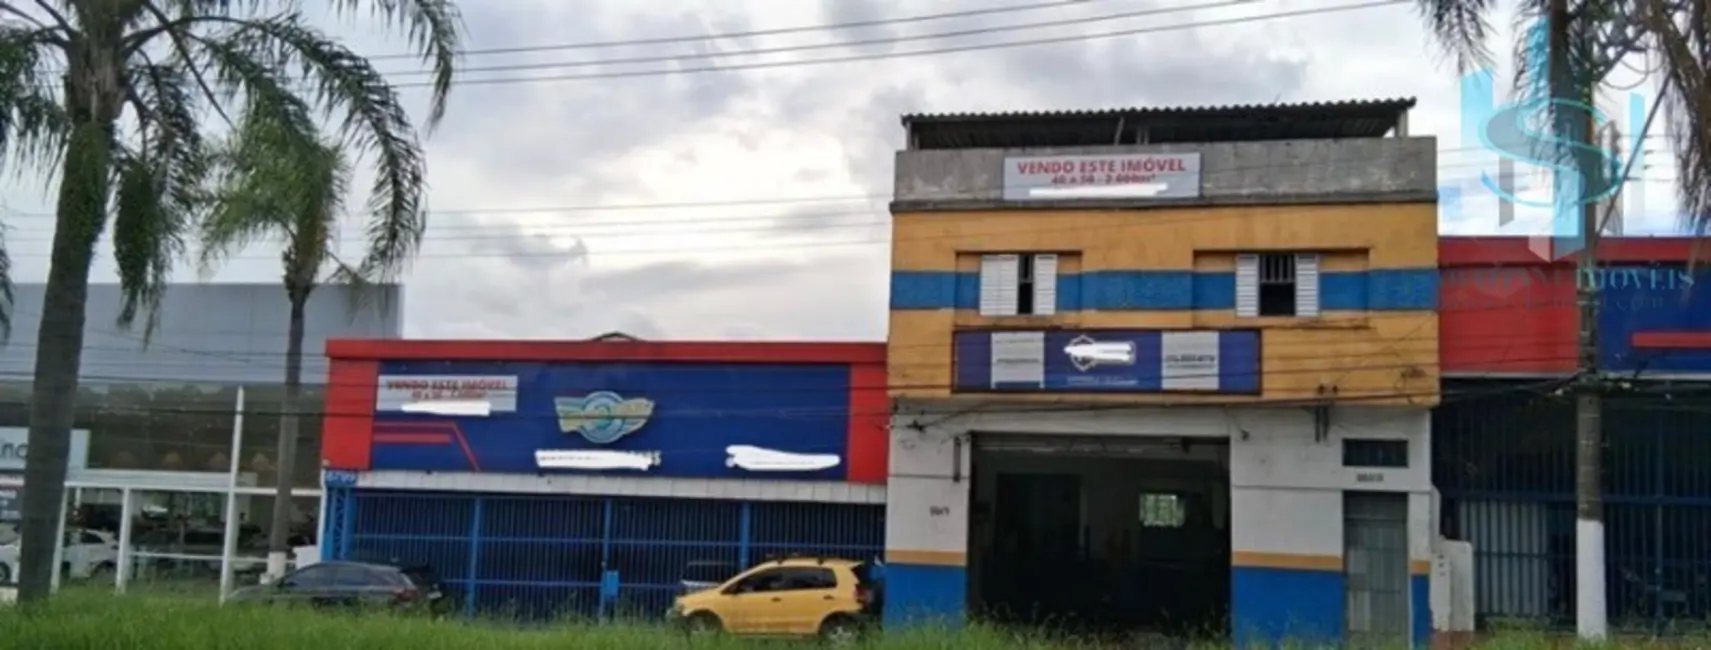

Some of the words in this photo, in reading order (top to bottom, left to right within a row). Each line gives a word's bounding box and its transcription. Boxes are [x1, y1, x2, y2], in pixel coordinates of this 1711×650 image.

[1017, 160, 1075, 175] VENDO
[1079, 159, 1117, 174] ESTE
[1121, 157, 1186, 173] IMÓVEL
